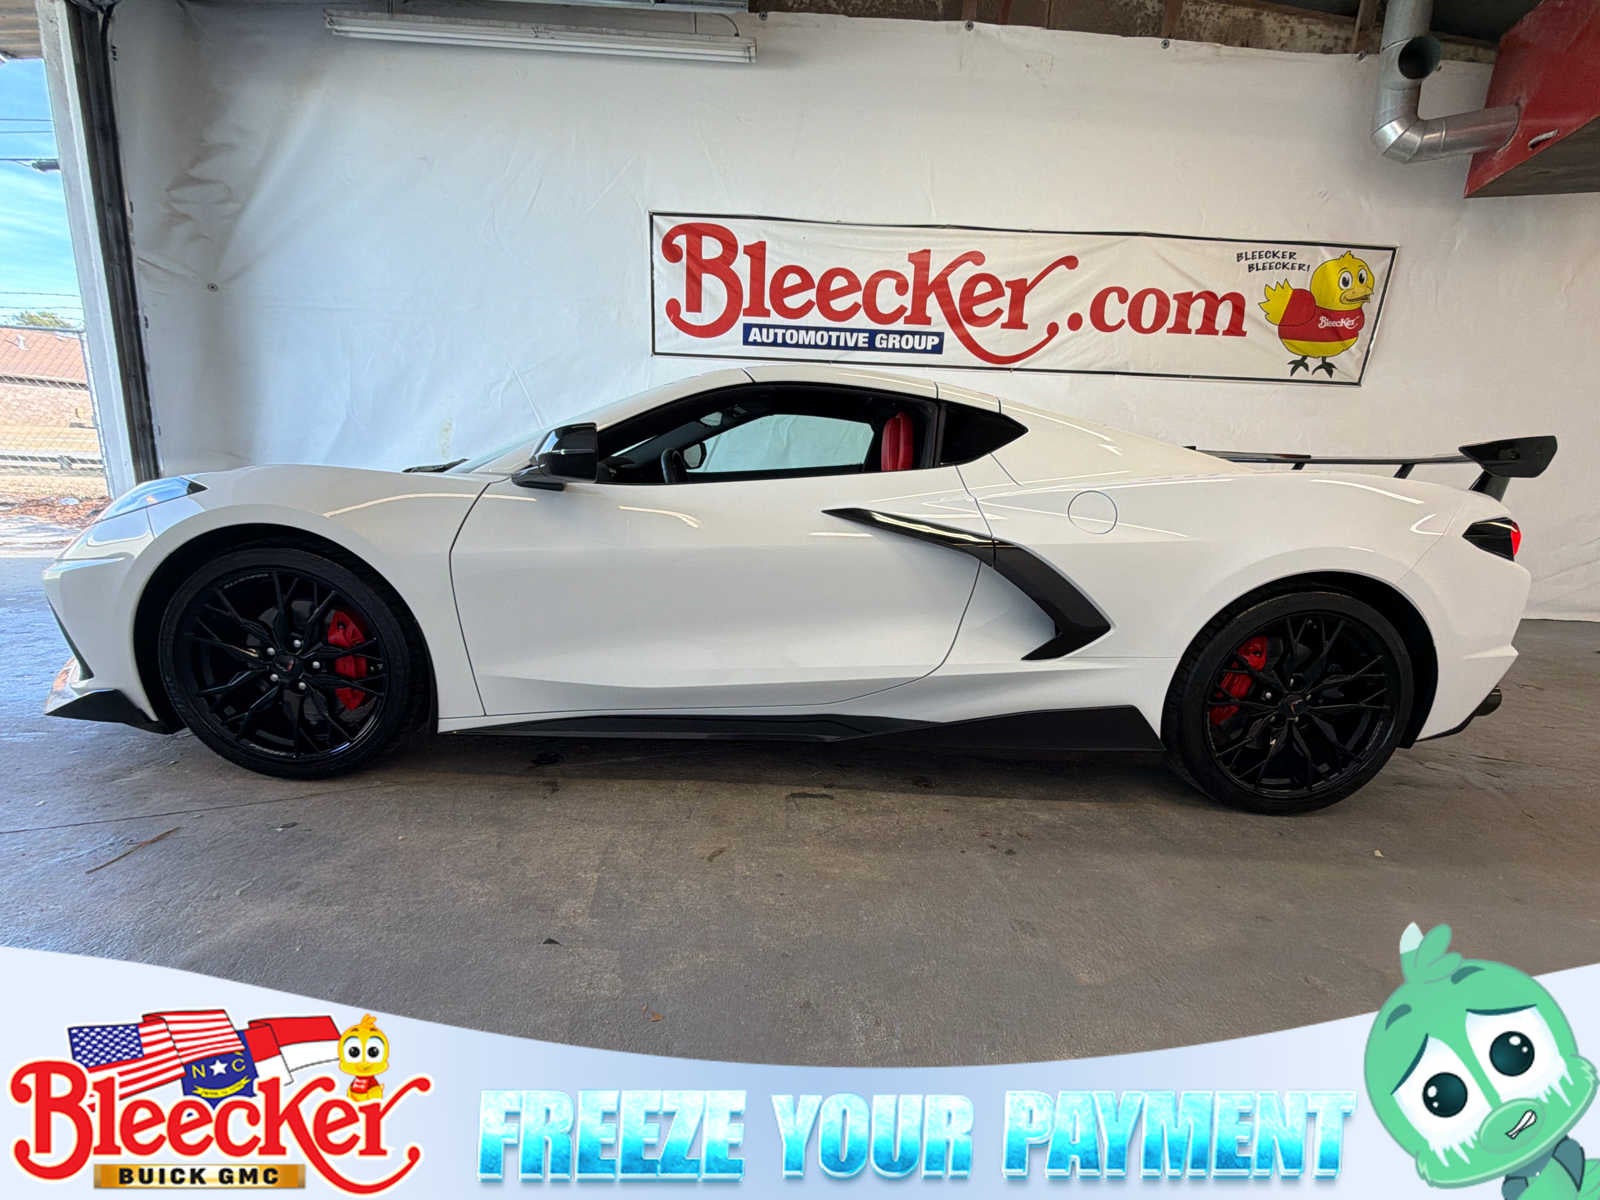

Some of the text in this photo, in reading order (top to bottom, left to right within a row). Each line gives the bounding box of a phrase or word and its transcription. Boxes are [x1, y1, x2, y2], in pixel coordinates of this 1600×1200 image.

[1236, 250, 1297, 262] BLEECKER
[1248, 262, 1311, 272] BLEECKER!
[748, 327, 940, 350] AUTOMOTIVE GROUP
